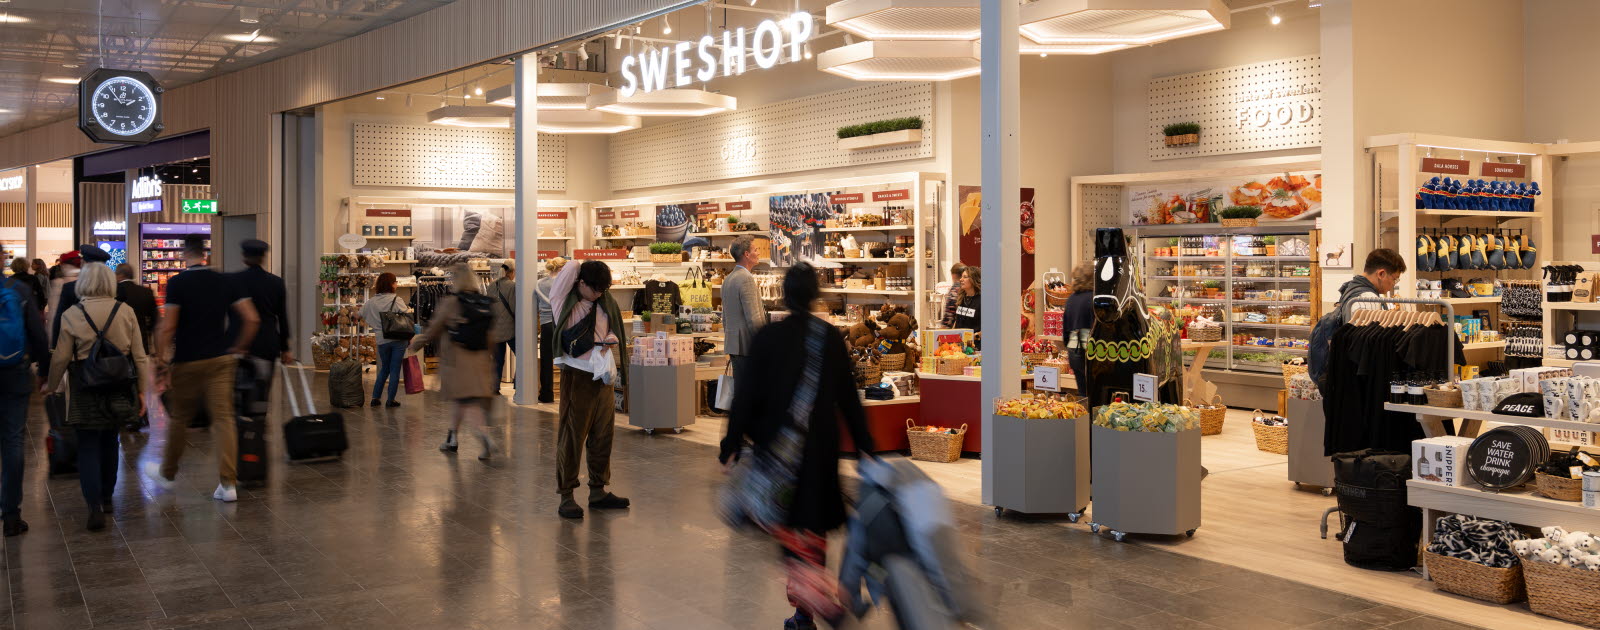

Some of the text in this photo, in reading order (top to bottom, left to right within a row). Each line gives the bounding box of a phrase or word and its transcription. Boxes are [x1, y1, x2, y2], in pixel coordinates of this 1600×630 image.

[621, 11, 813, 98] SWESHOP
[1236, 102, 1315, 129] FOOD
[132, 173, 162, 199] Adlibris
[690, 294, 709, 302] PEACE
[1502, 404, 1535, 413] PEACE
[1491, 440, 1512, 450] SAVE
[1487, 448, 1514, 459] WATER
[1485, 456, 1511, 467] DRINK
